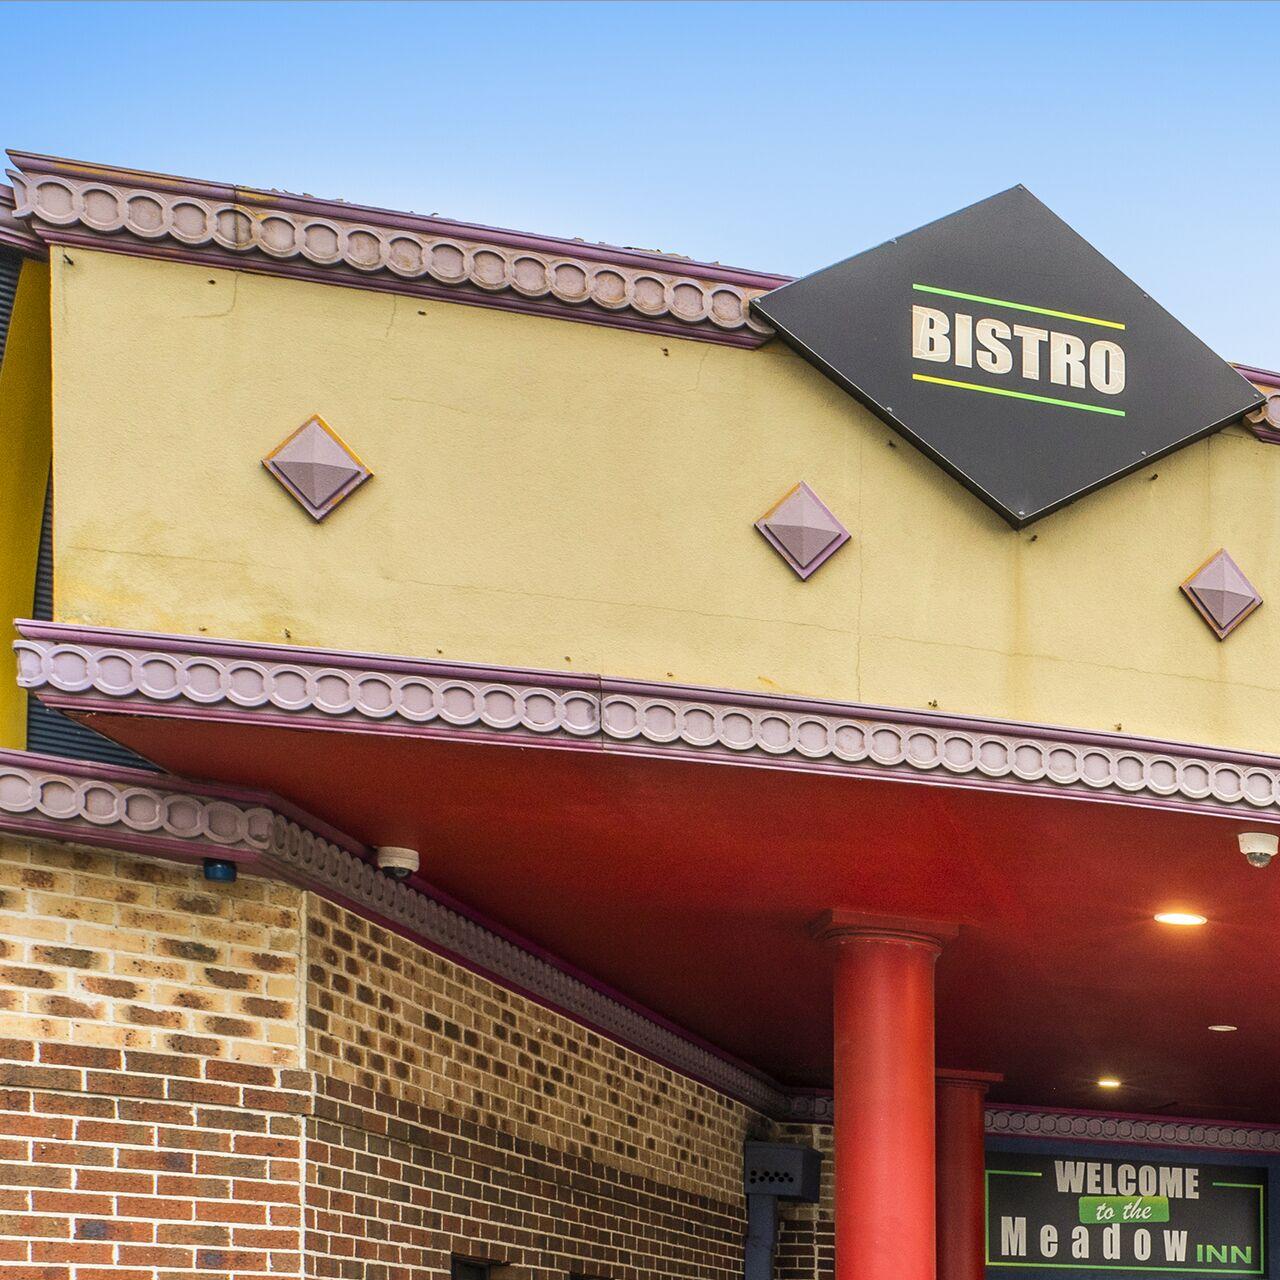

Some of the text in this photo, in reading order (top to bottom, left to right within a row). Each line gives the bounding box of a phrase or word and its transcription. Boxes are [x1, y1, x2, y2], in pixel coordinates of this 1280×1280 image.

[912, 304, 1126, 396] BISTRO
[1054, 1160, 1200, 1200] WELCOME
[1095, 1197, 1153, 1221] to the
[1000, 1216, 1253, 1265] Meadow INN
